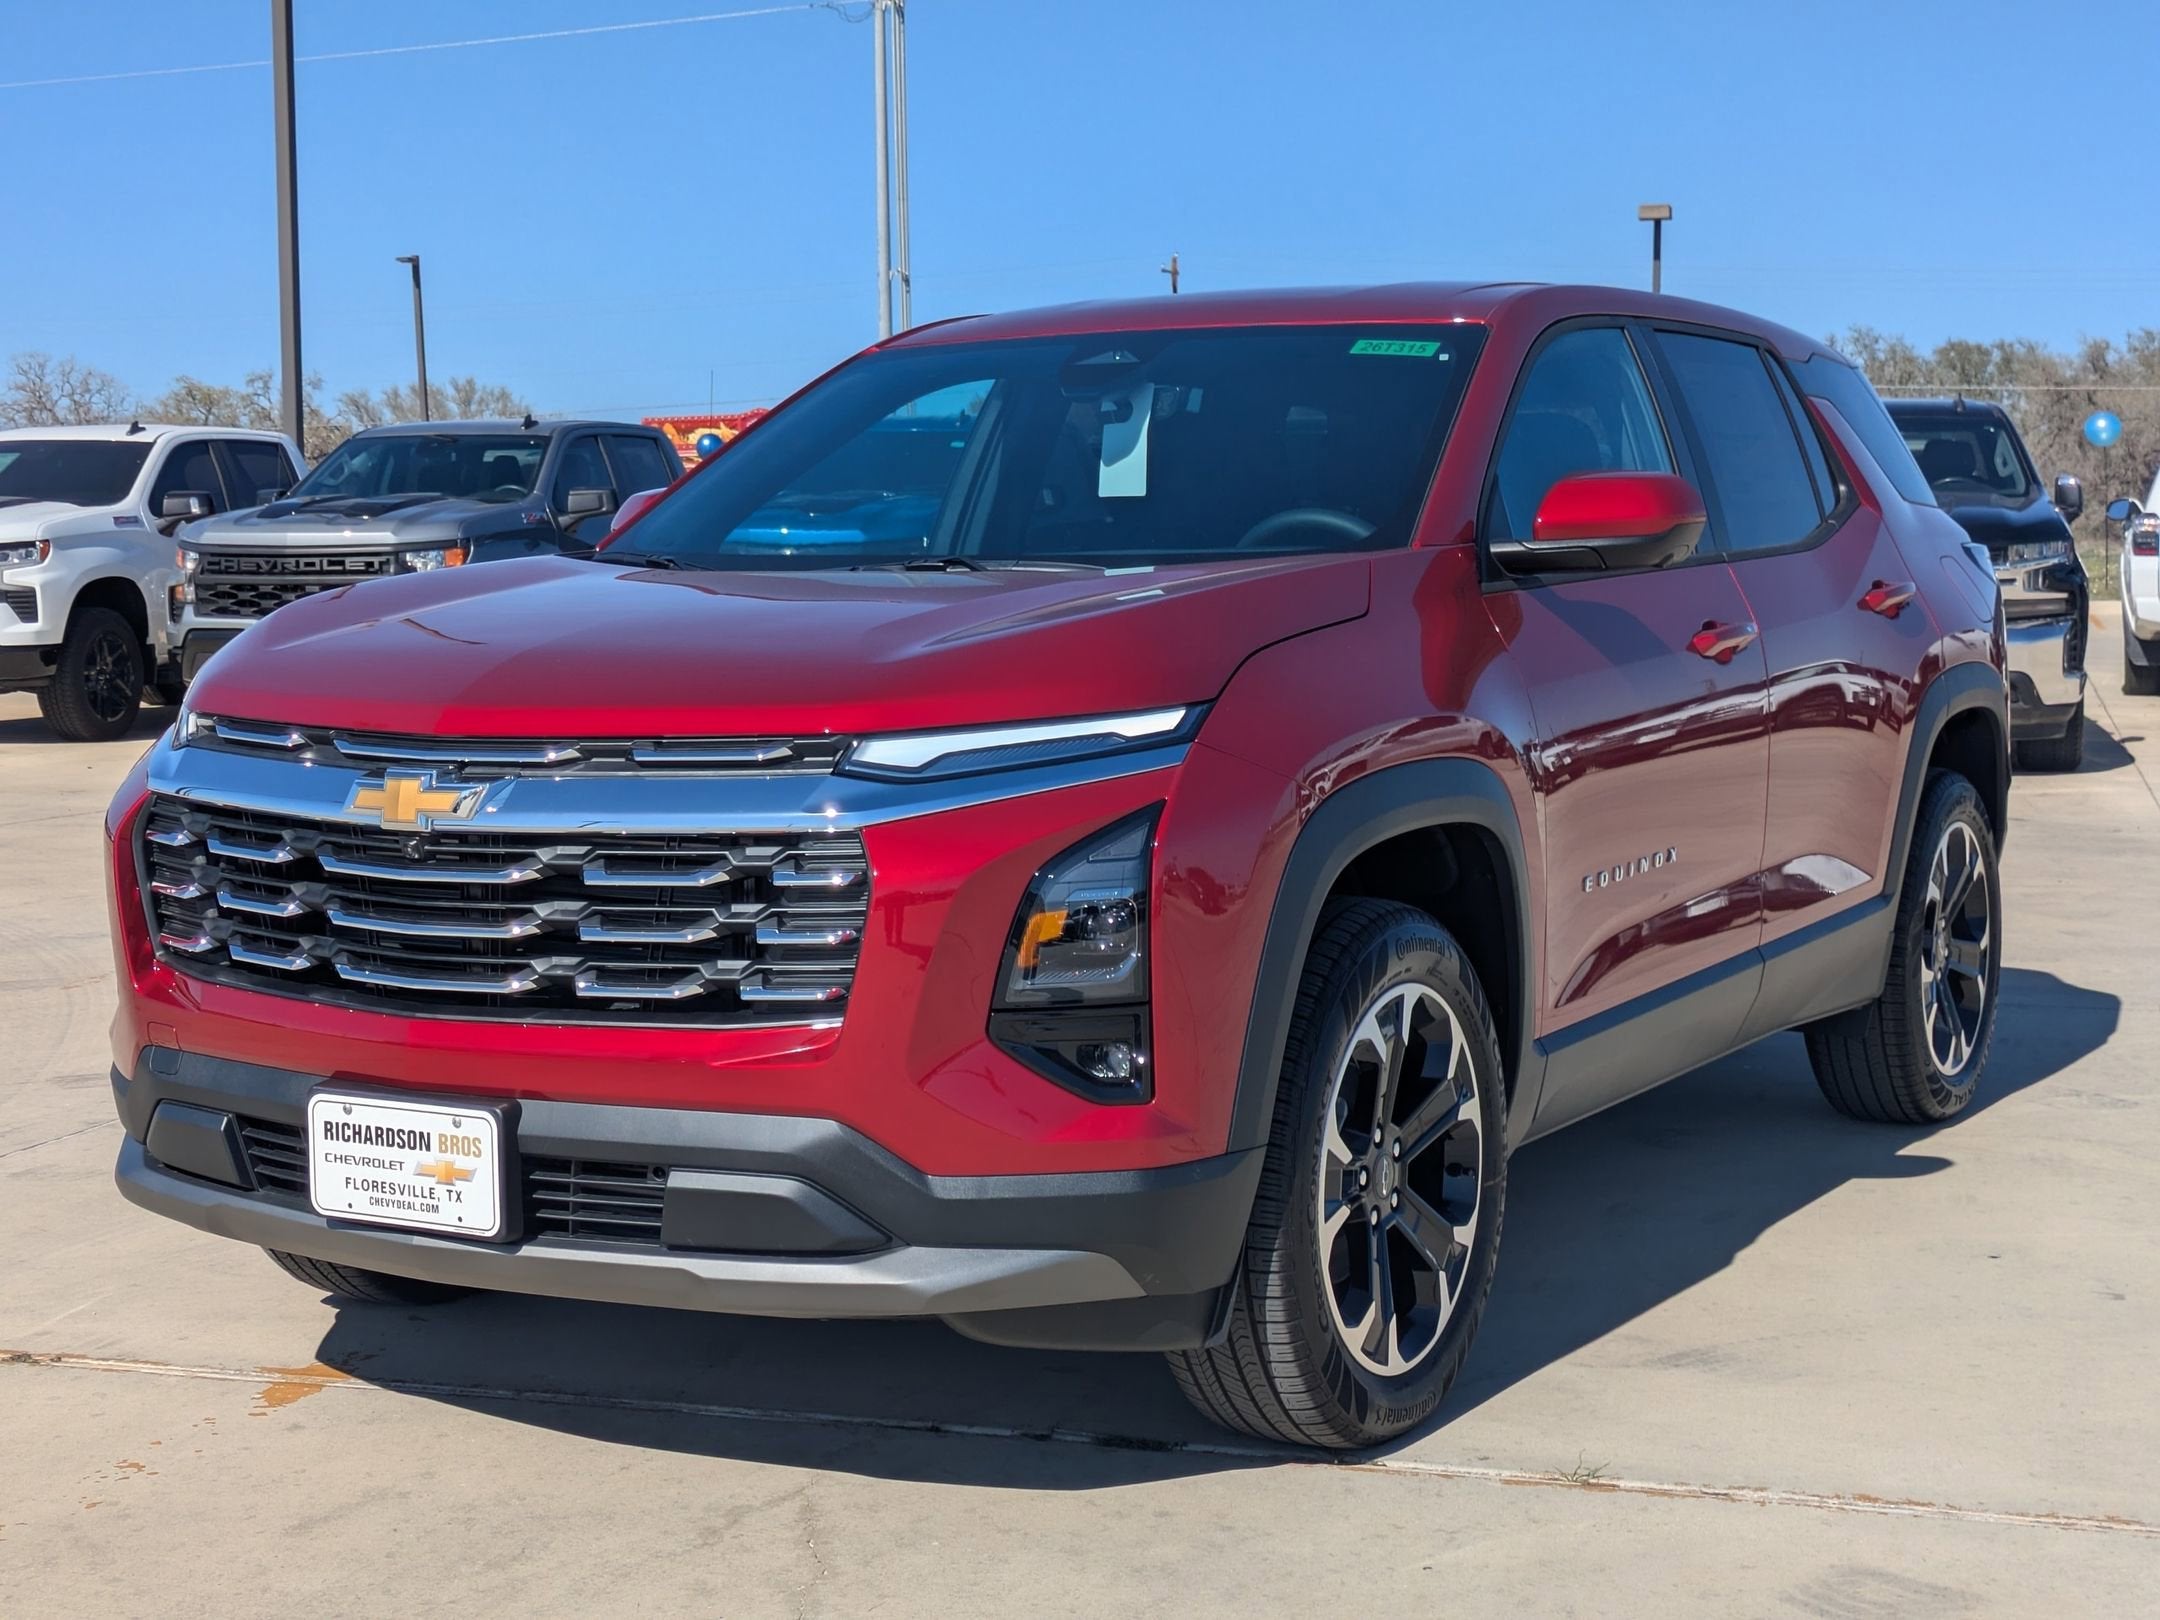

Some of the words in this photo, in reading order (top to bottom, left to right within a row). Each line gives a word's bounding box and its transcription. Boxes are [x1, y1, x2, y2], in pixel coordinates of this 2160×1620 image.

[1360, 341, 1428, 354] 26T315
[203, 556, 388, 573] CHEVROLET
[1582, 846, 1677, 893] EQUINOX
[1395, 932, 1446, 961] Continental
[323, 1120, 431, 1152] RICHARDSON
[438, 1132, 482, 1158] BROS
[324, 1153, 405, 1171] CHEVROLET
[345, 1177, 441, 1202] FLORESVILLE,
[446, 1190, 463, 1203] TX
[369, 1196, 440, 1214] CHEVYDEAL.COM
